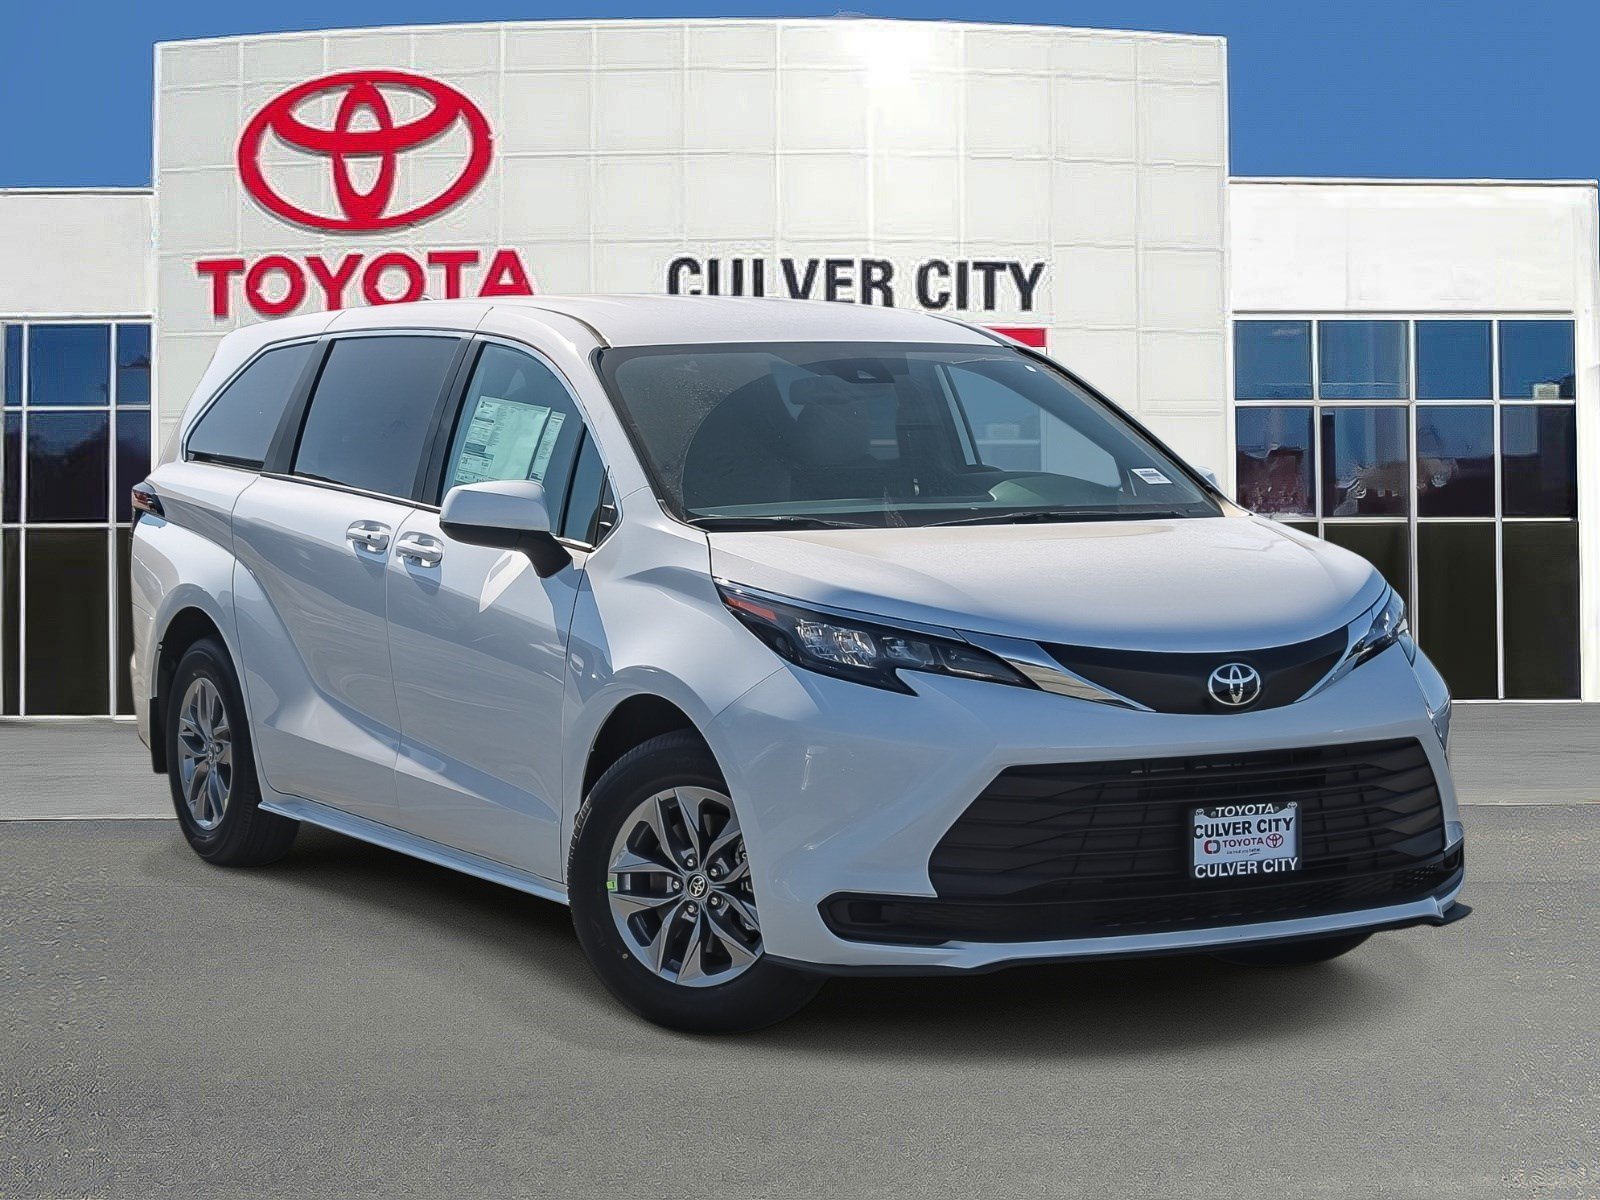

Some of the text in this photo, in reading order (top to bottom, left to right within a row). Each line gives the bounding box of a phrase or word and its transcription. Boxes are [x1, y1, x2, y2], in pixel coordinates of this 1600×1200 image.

[197, 250, 534, 317] TOYOTA
[668, 257, 1045, 311] CULVER CITY
[1216, 803, 1274, 817] TOYOTA
[1194, 817, 1294, 839] CULVER CITY
[1223, 837, 1264, 848] TOYOTA
[1195, 857, 1298, 878] CULVER CITY
